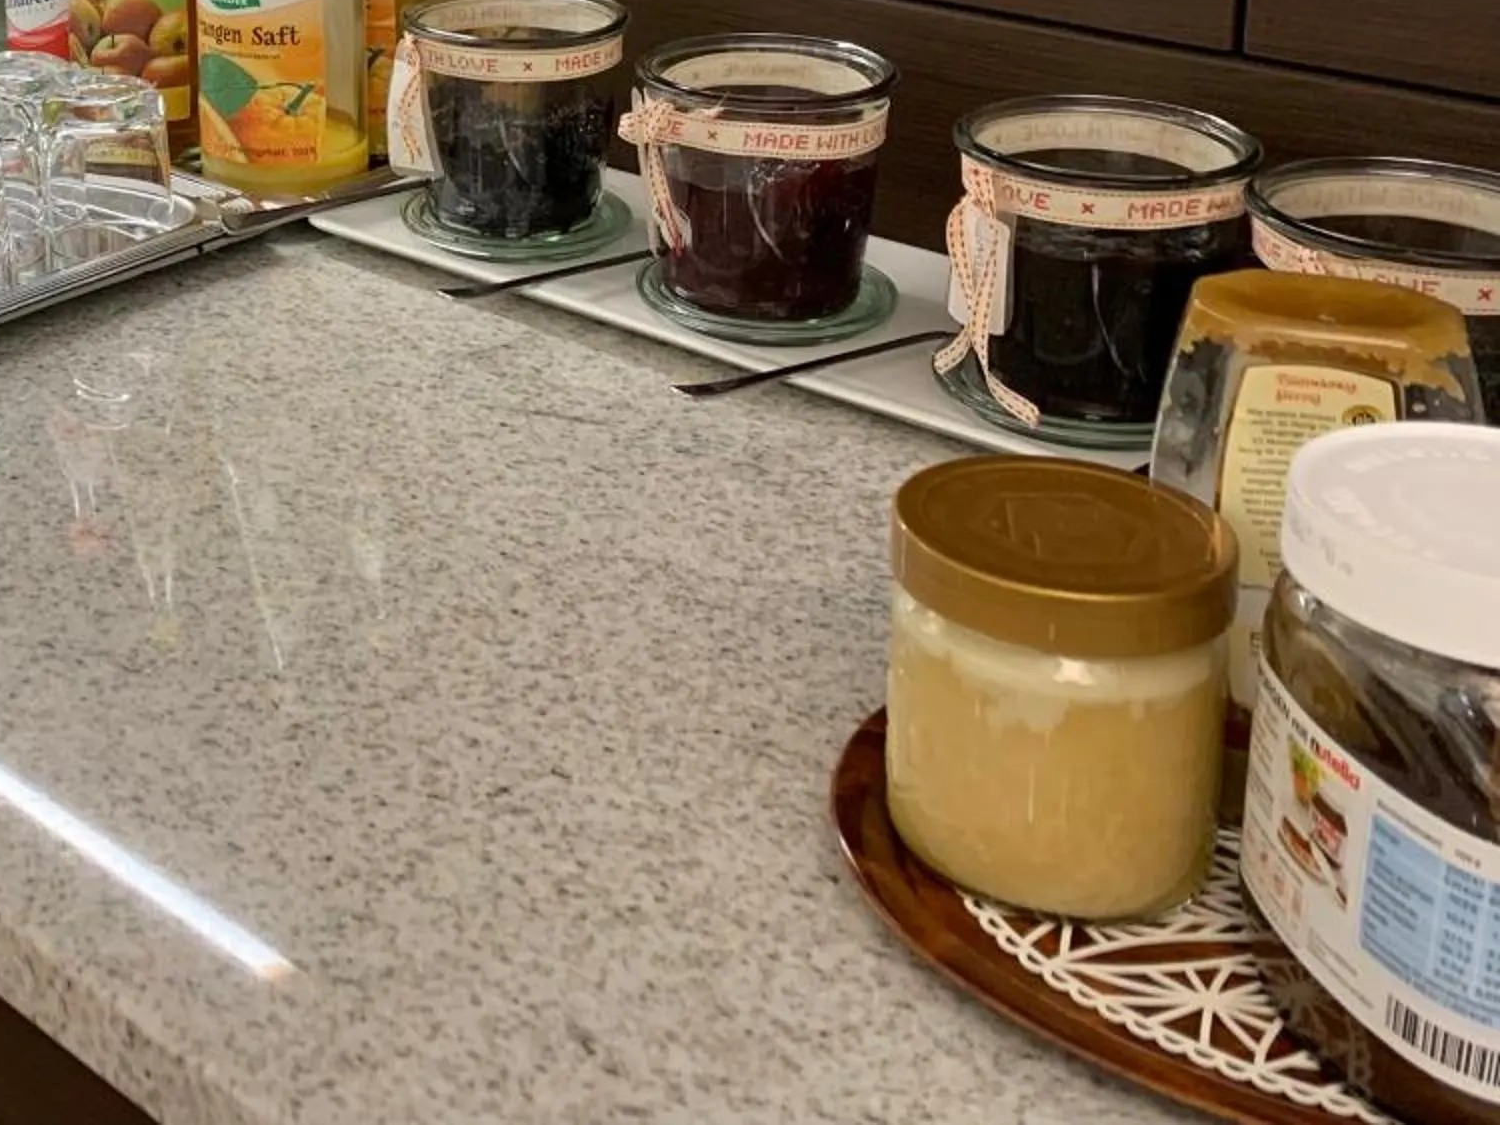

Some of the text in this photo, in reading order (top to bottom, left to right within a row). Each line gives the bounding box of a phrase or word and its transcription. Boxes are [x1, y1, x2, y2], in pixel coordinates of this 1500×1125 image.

[251, 23, 301, 46] Saft
[447, 55, 501, 73] LOVE
[555, 51, 602, 72] MADE
[743, 131, 810, 151] MADE
[816, 129, 859, 149] WITH
[1002, 184, 1050, 211] OVE
[1127, 198, 1202, 220] MADE
[1310, 736, 1361, 791] nutella
